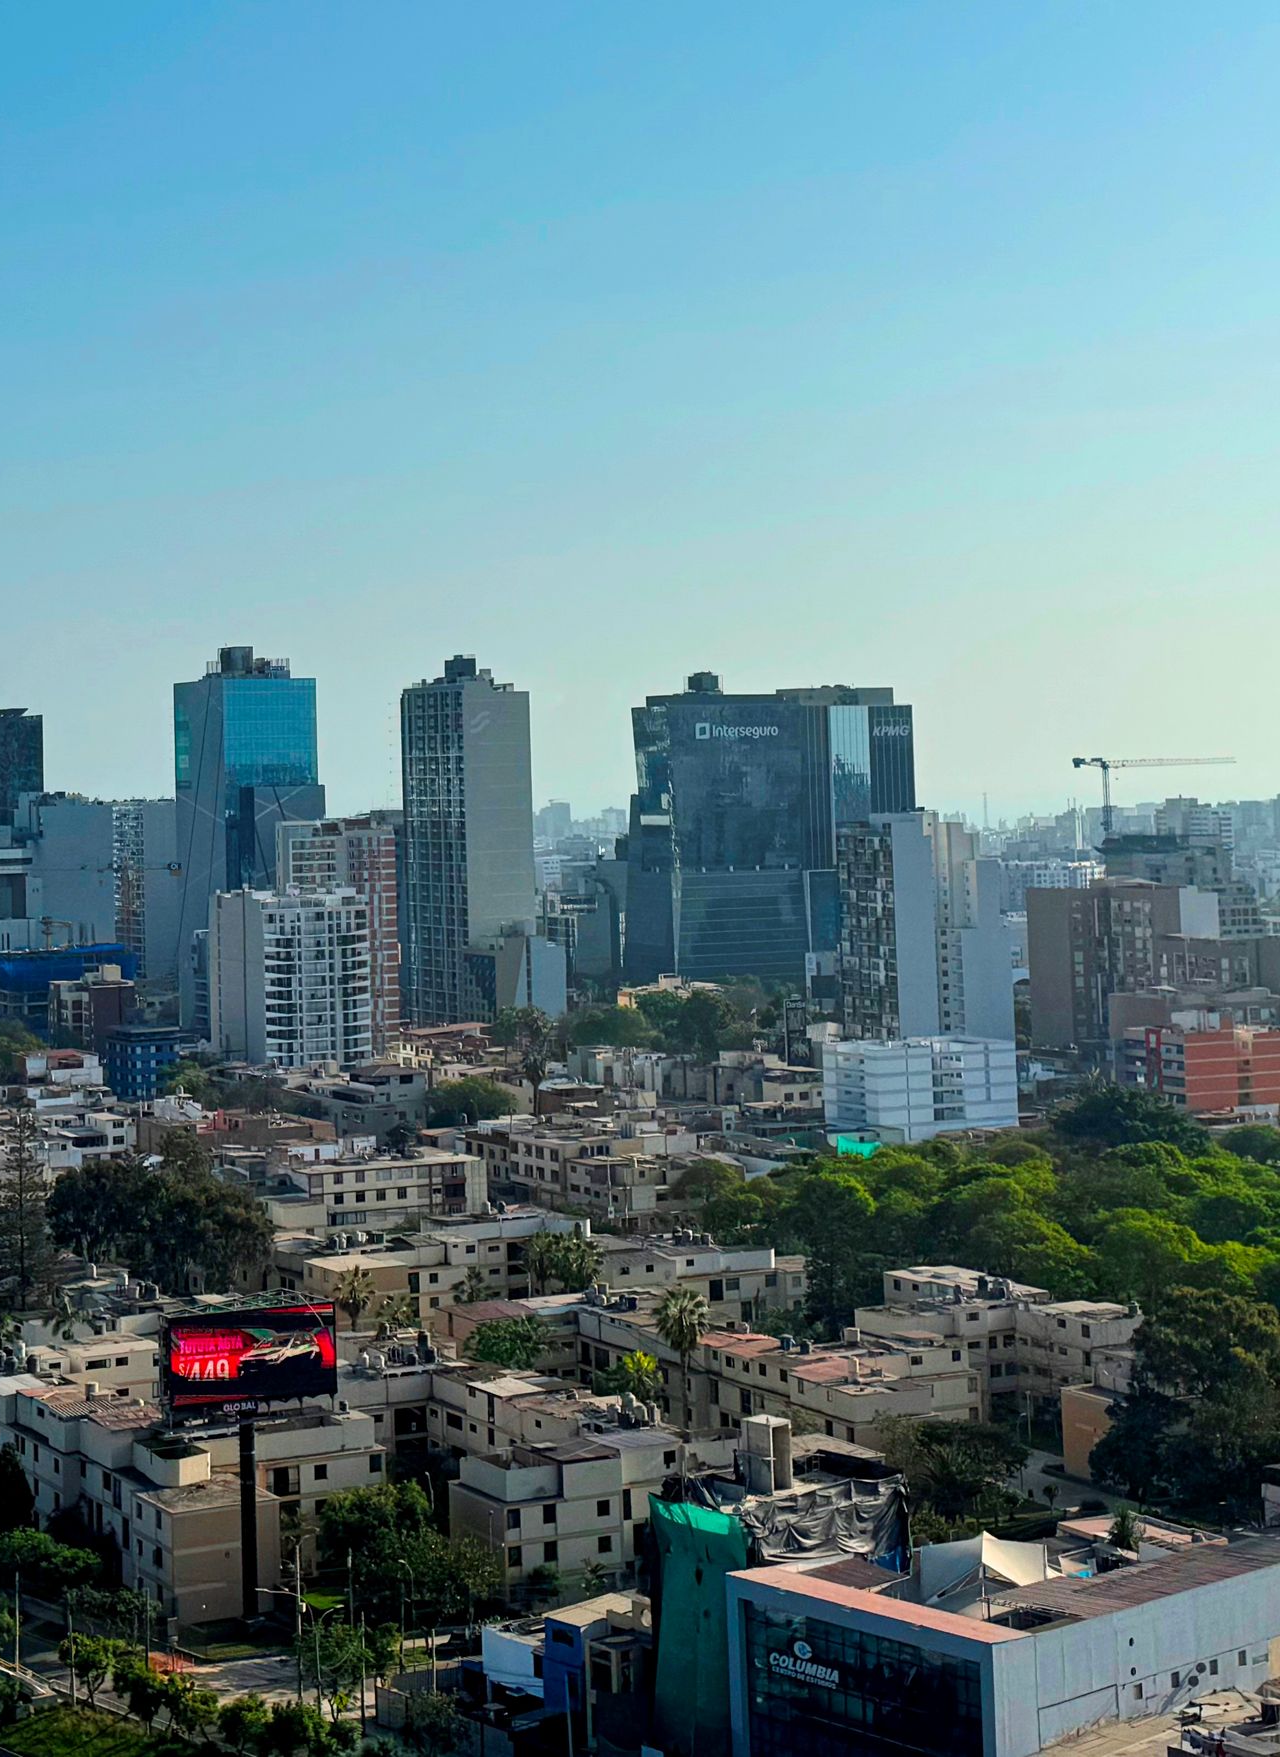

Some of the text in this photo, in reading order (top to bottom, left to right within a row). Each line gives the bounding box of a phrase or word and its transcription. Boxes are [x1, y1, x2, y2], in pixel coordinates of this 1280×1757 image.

[712, 724, 779, 739] Interseguro
[872, 725, 909, 736] KPMG
[223, 1402, 256, 1412] GLOBAL
[770, 1652, 839, 1683] COLUMBIA
[772, 1666, 796, 1677] CENTRO
[797, 1673, 805, 1681] DE
